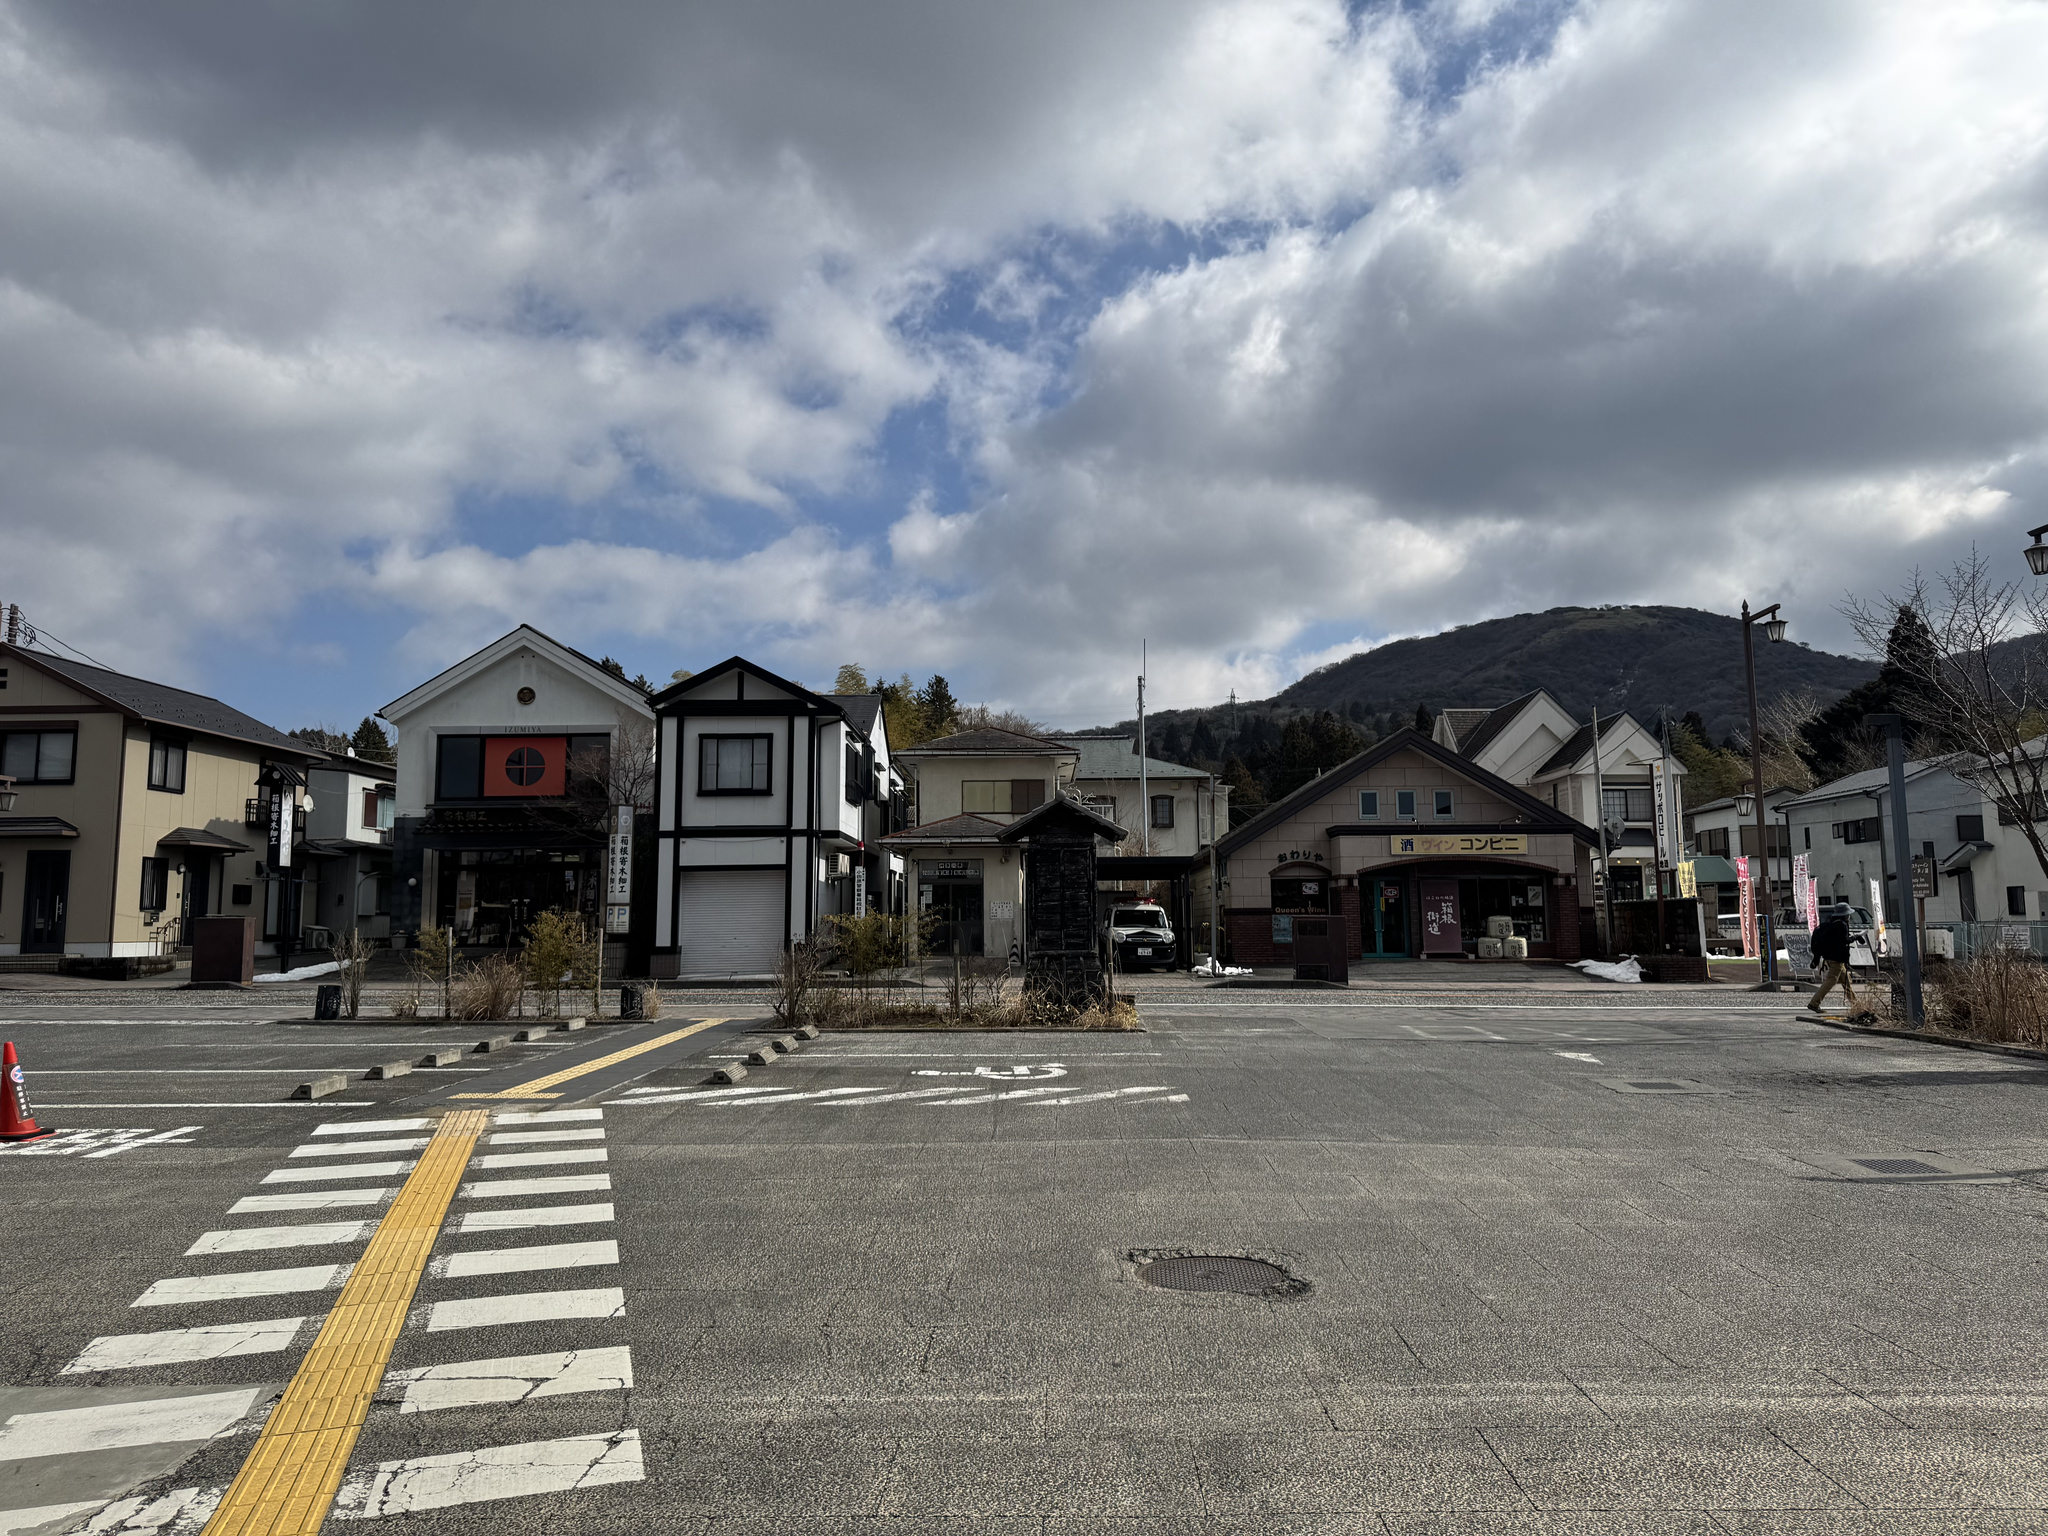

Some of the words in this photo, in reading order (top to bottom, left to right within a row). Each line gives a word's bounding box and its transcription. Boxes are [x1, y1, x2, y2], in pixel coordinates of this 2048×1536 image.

[504, 725, 542, 733] IZUMIYA
[269, 794, 280, 845] 箱根寄木細工
[1656, 781, 1667, 858] サッポロビール
[1400, 838, 1414, 852] 酒
[1460, 837, 1519, 850] コンビニ
[1277, 850, 1324, 863] おわりや
[618, 835, 629, 893] 箱根寄木細工
[608, 908, 614, 920] P
[617, 907, 627, 920] P
[1439, 902, 1457, 924] 箱根
[1426, 911, 1441, 935] 街道
